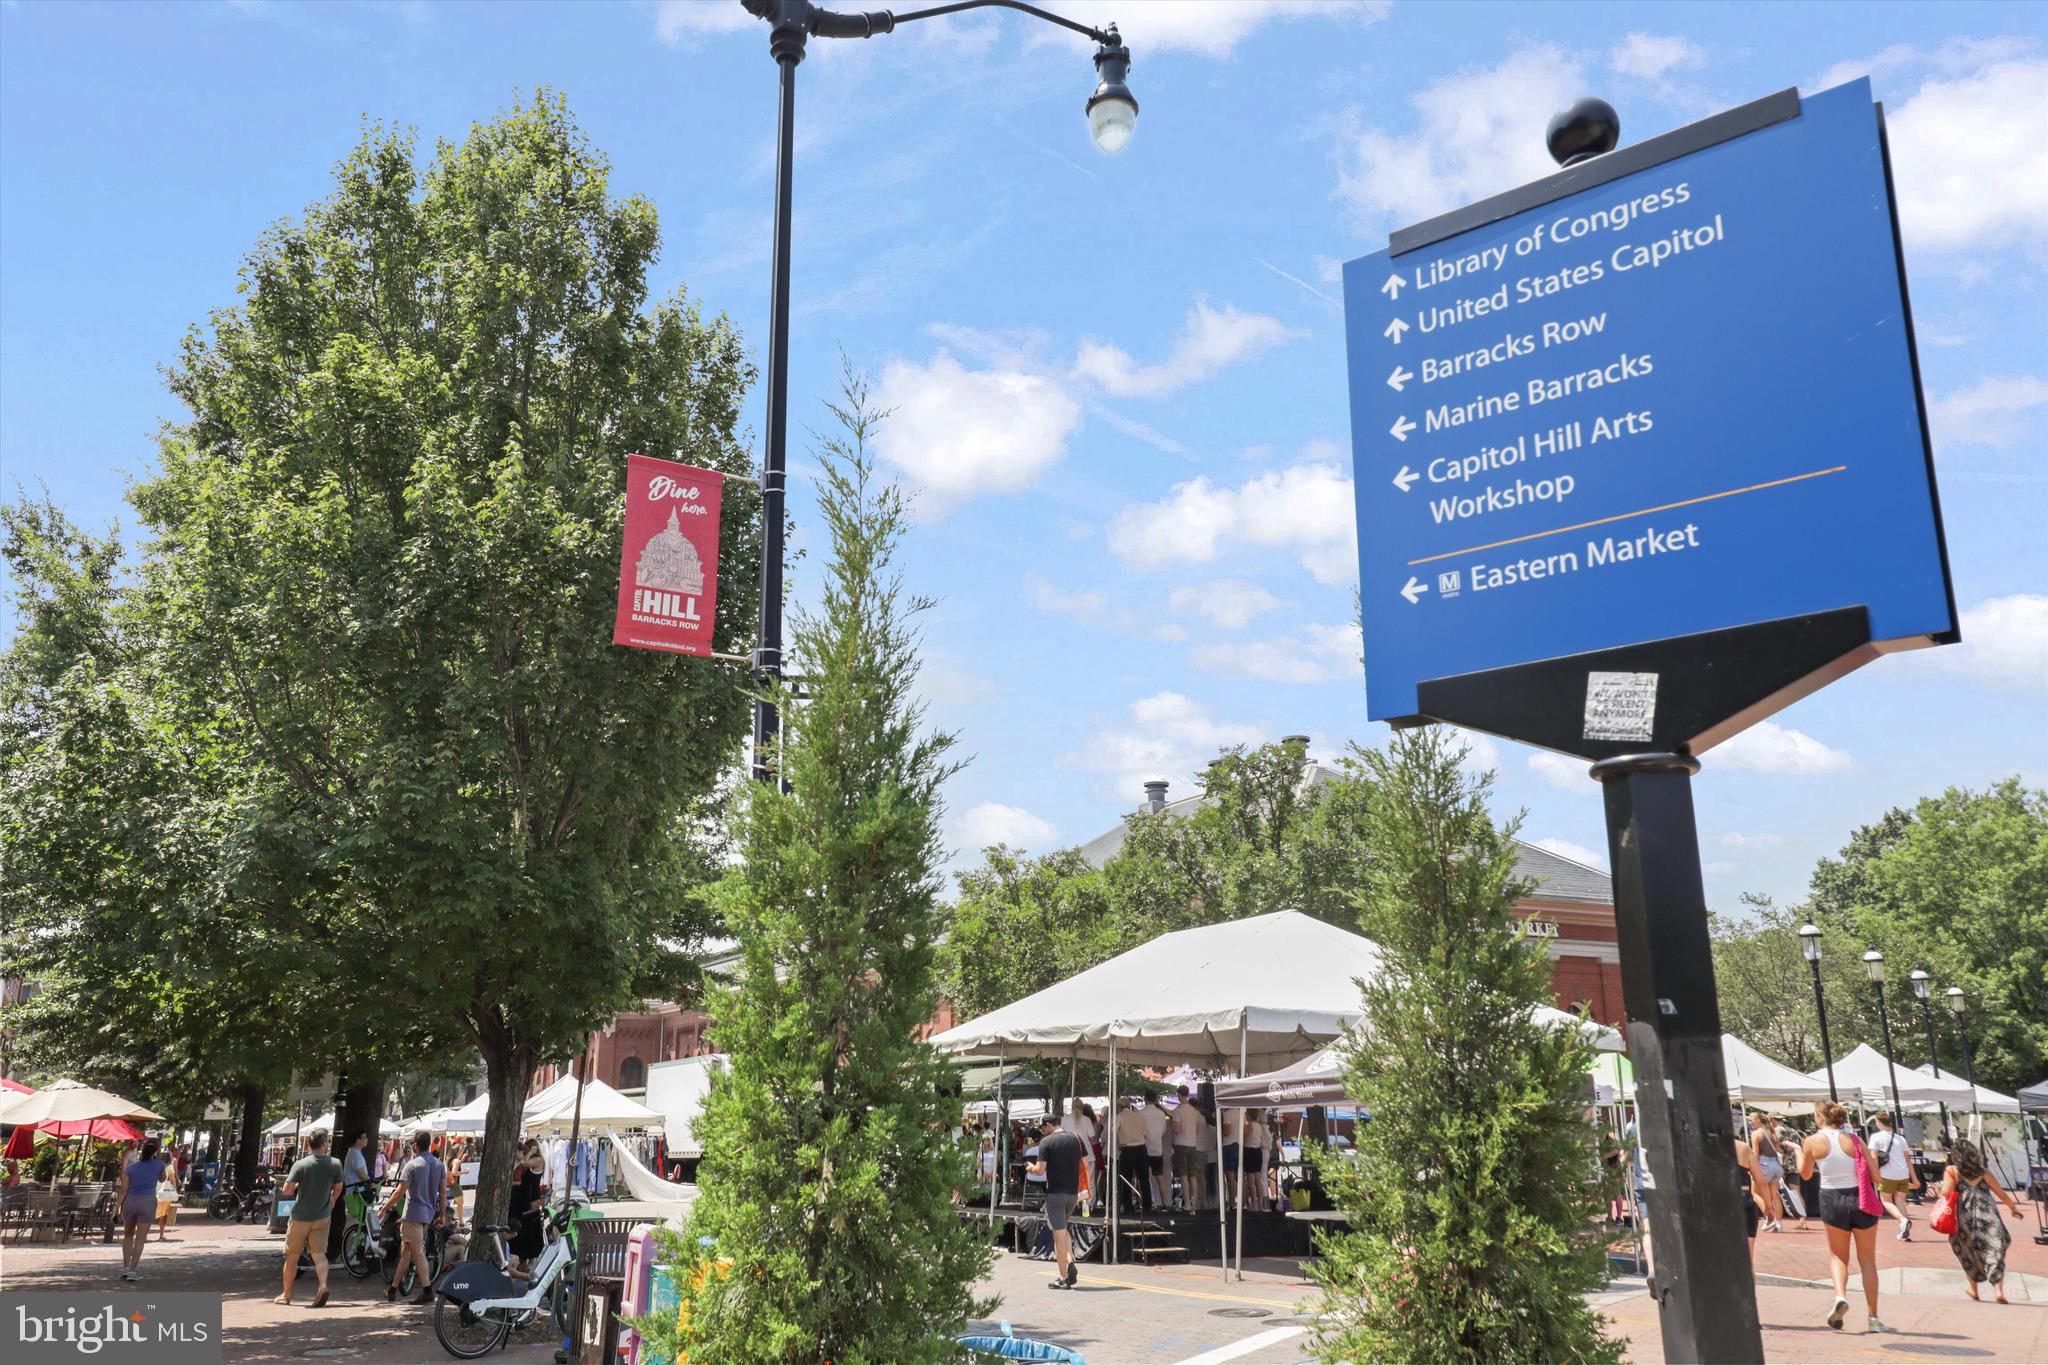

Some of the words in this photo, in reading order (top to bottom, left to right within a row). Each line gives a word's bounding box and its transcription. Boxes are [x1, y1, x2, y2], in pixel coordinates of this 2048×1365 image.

[1415, 243, 1508, 290] Library
[1515, 224, 1545, 256] of
[1550, 183, 1691, 243] Congress
[1418, 283, 1509, 333] United
[1516, 260, 1604, 303] States
[1611, 214, 1724, 272] Capitol
[1422, 334, 1536, 384] Barracks
[1542, 312, 1607, 348] Row
[1425, 391, 1520, 433] Marine
[1527, 353, 1654, 405] Barracks
[1427, 436, 1526, 483] Capitol
[1534, 421, 1582, 458] Hill
[1591, 411, 1654, 444] Arts
[649, 476, 700, 500] Dine
[681, 502, 708, 515] here.
[1429, 474, 1575, 524] Workshop
[1471, 552, 1578, 591] Eastern
[1587, 523, 1700, 568] Market
[632, 613, 677, 627] BARRACKS
[679, 621, 699, 631] ROW
[642, 590, 701, 621] HILL
[1611, 699, 1646, 709] SILENT
